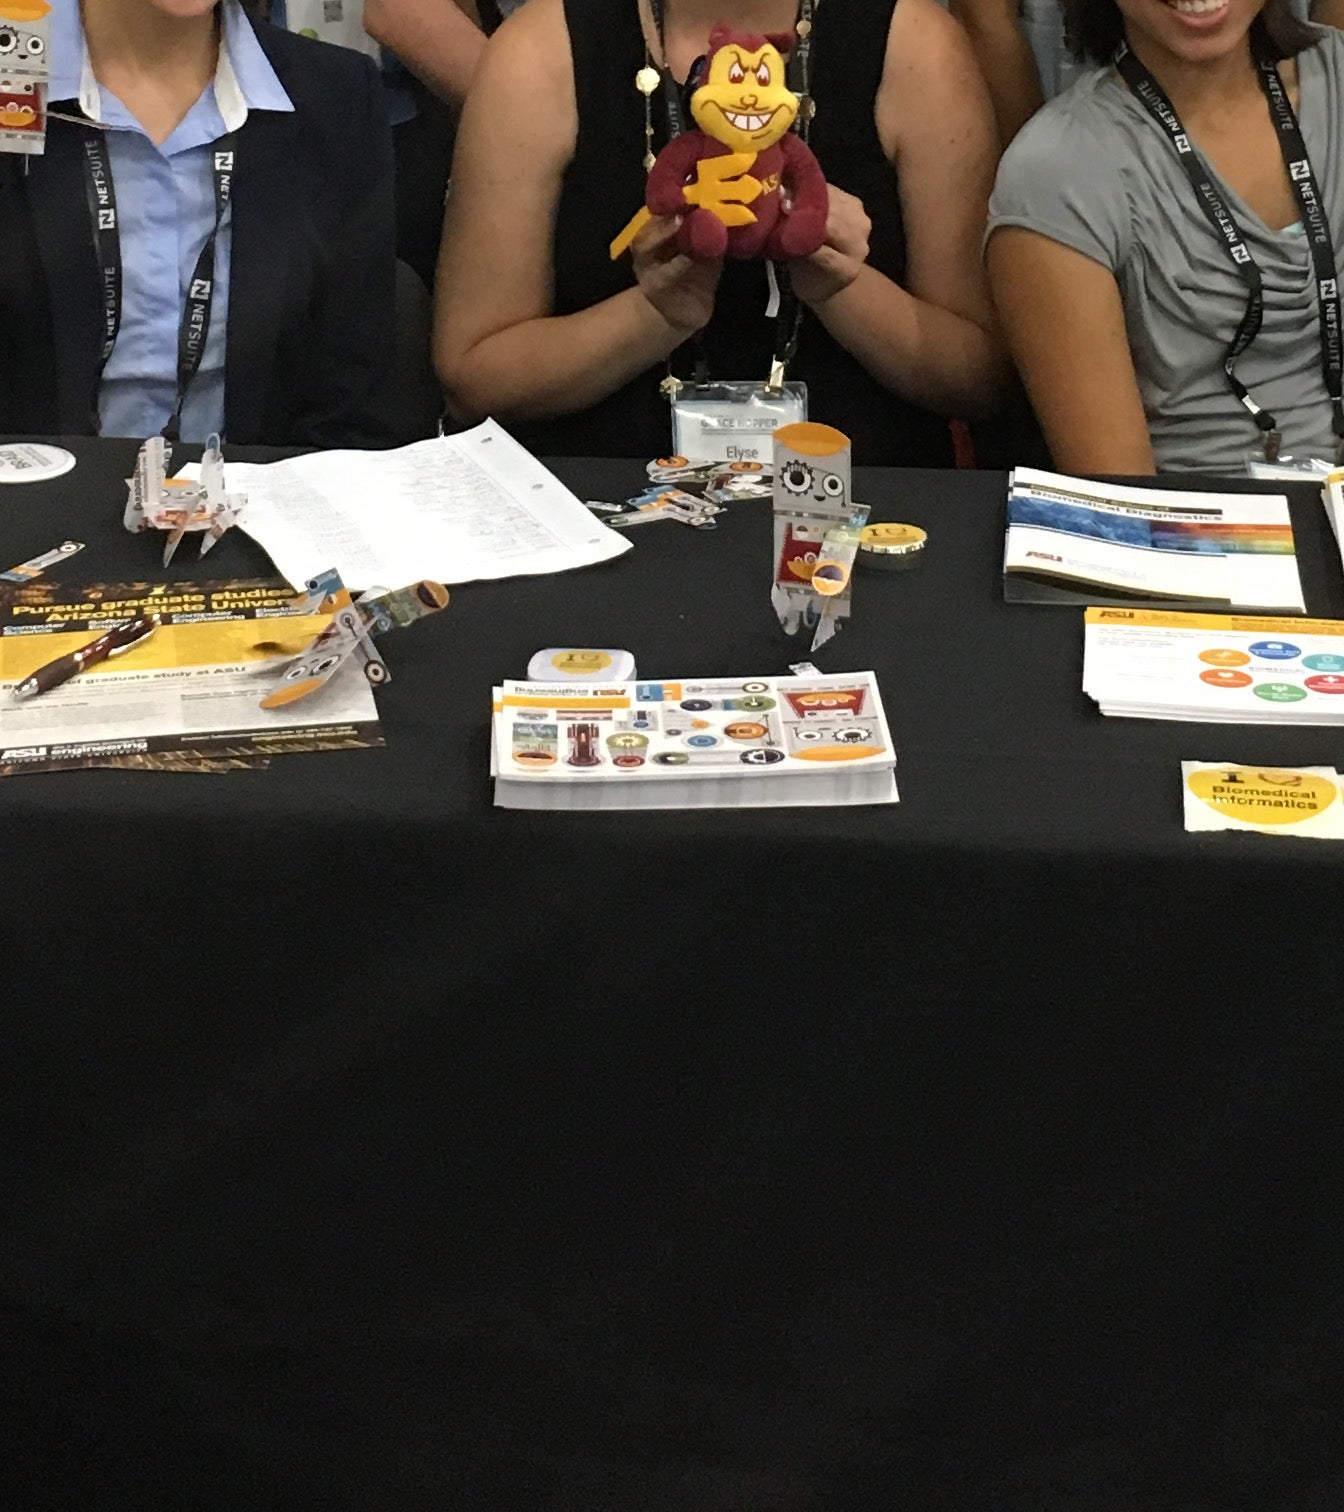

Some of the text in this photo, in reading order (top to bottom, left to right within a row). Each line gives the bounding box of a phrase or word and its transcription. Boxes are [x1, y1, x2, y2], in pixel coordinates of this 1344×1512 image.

[726, 446, 759, 462] Elyse
[1031, 489, 1120, 513] Biomedical
[1126, 508, 1223, 521] Diagnostics
[13, 589, 295, 615] Pursue graduate studies
[46, 597, 285, 622] Arizona State Univer
[214, 666, 246, 675] ASU
[1, 741, 148, 759] ASU engineering
[1212, 785, 1317, 800] Biomedical
[1212, 794, 1318, 812] Informatics
